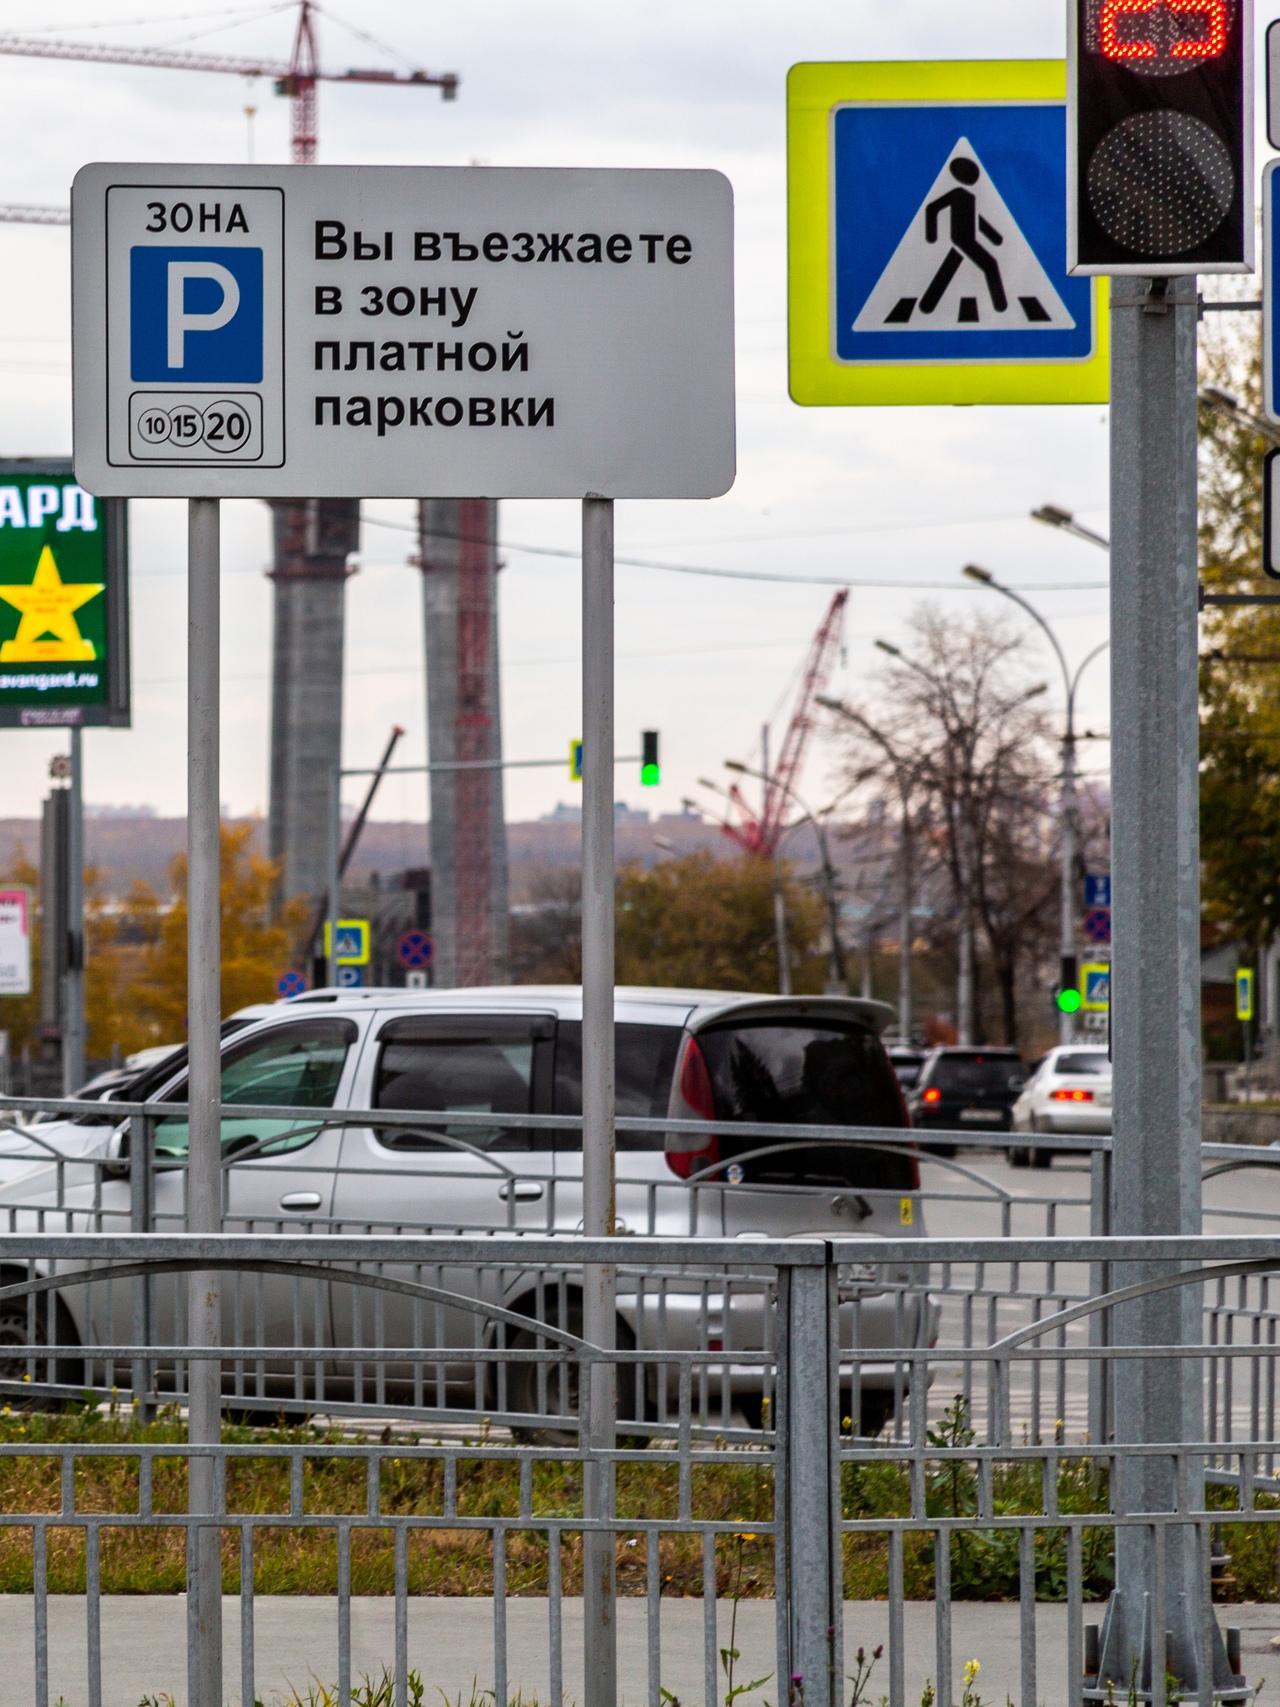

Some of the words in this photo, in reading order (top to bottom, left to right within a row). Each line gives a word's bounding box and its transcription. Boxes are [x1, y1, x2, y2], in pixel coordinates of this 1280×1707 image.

[145, 203, 250, 234] ЗОНА
[314, 220, 394, 262] Вы
[413, 231, 693, 265] въезжаете
[166, 260, 241, 369] P
[314, 284, 343, 316] в
[359, 285, 479, 327] зону
[314, 330, 530, 373] платной
[145, 416, 166, 435] 10
[172, 414, 198, 438] 15
[206, 412, 245, 441] 20
[314, 395, 556, 437] парковки
